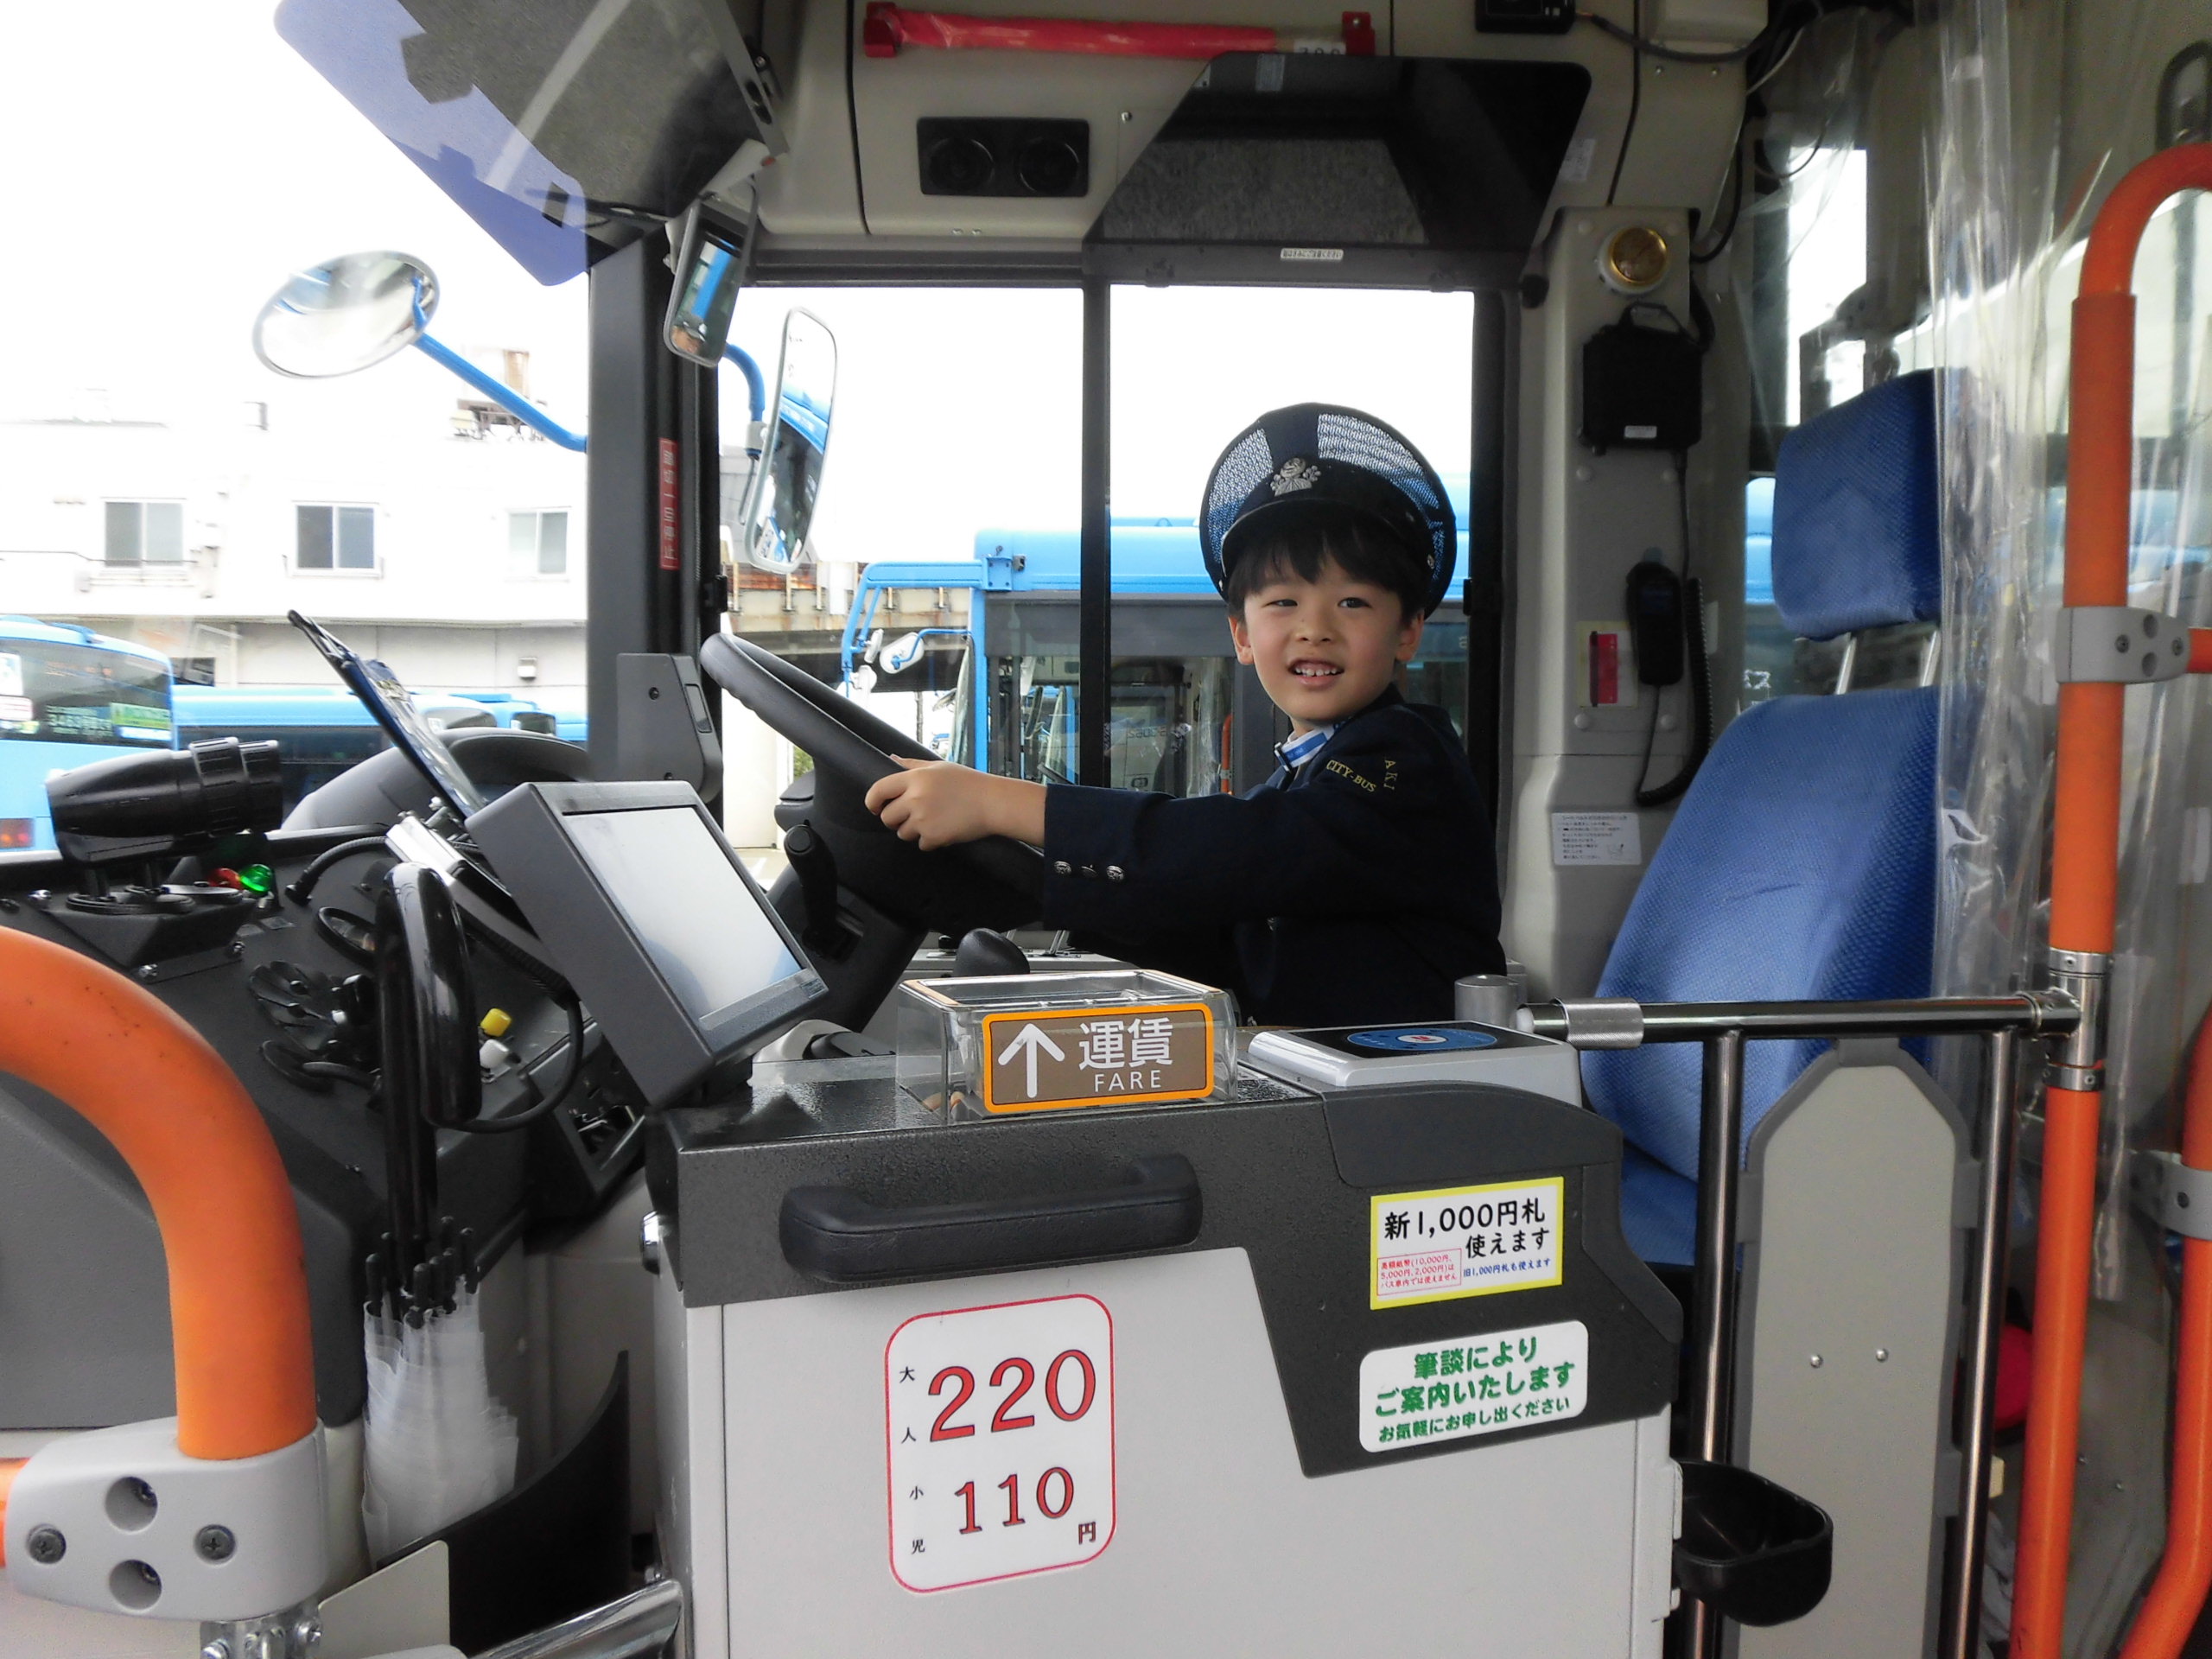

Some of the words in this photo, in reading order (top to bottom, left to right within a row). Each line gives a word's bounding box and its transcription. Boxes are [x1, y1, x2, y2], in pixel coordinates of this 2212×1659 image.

[1326, 760, 1376, 792] CITY-BUS
[1078, 1017, 1173, 1071] 運賃
[1094, 1070, 1161, 1092] FARE
[1384, 1198, 1546, 1241] 新1,000円札
[1465, 1227, 1550, 1259] 使えます
[1414, 1336, 1537, 1380] 筆談により
[928, 1349, 1096, 1442] 220
[1376, 1361, 1575, 1418] ご案内いたします
[1378, 1396, 1571, 1443] お気軽にお申し出ください
[954, 1466, 1075, 1535] 110
[1077, 1521, 1096, 1545] 円
